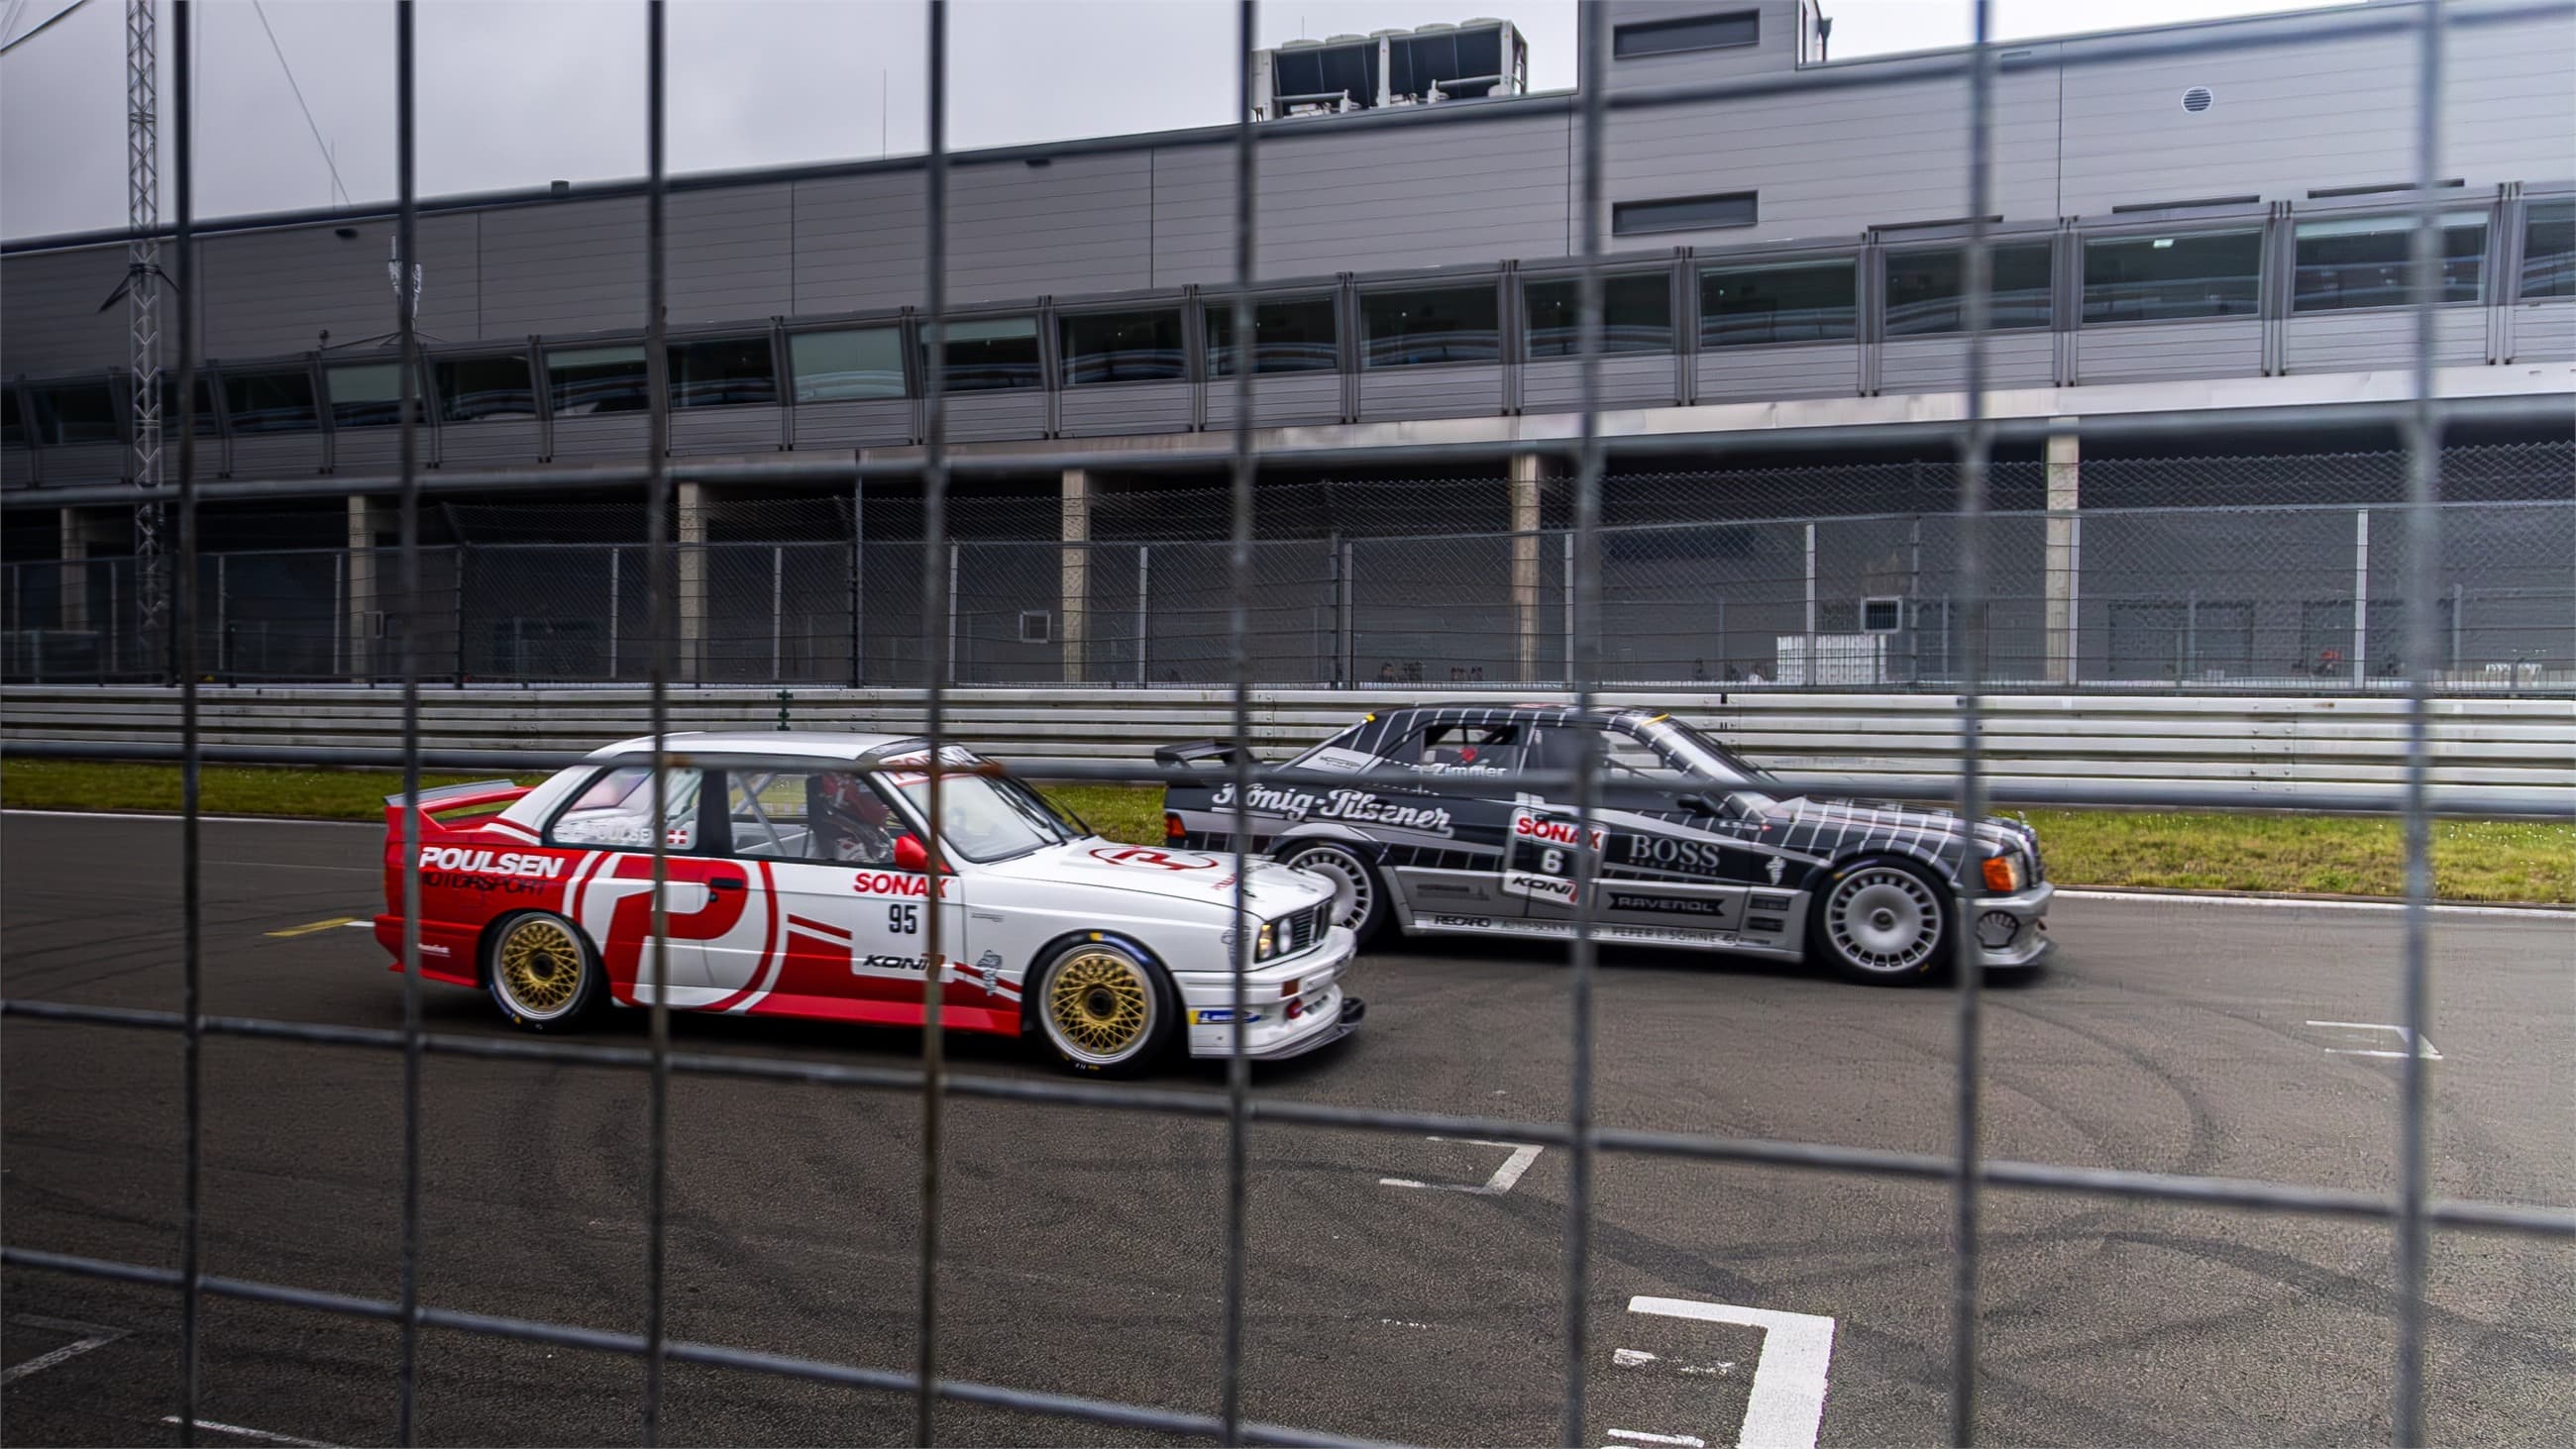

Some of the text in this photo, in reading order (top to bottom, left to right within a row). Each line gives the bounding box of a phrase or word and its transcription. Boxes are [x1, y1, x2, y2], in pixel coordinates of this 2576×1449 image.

[1516, 815, 1601, 851] SONAX
[418, 846, 566, 879] POULSEN
[1541, 849, 1563, 874] 6
[1630, 834, 1720, 869] BOSS
[853, 873, 948, 898] SONAX
[1512, 877, 1573, 895] KONI
[1618, 896, 1714, 912] RAVENOL
[889, 903, 917, 934] 95
[1435, 915, 1491, 928] RECARO
[863, 954, 929, 971] KONI
